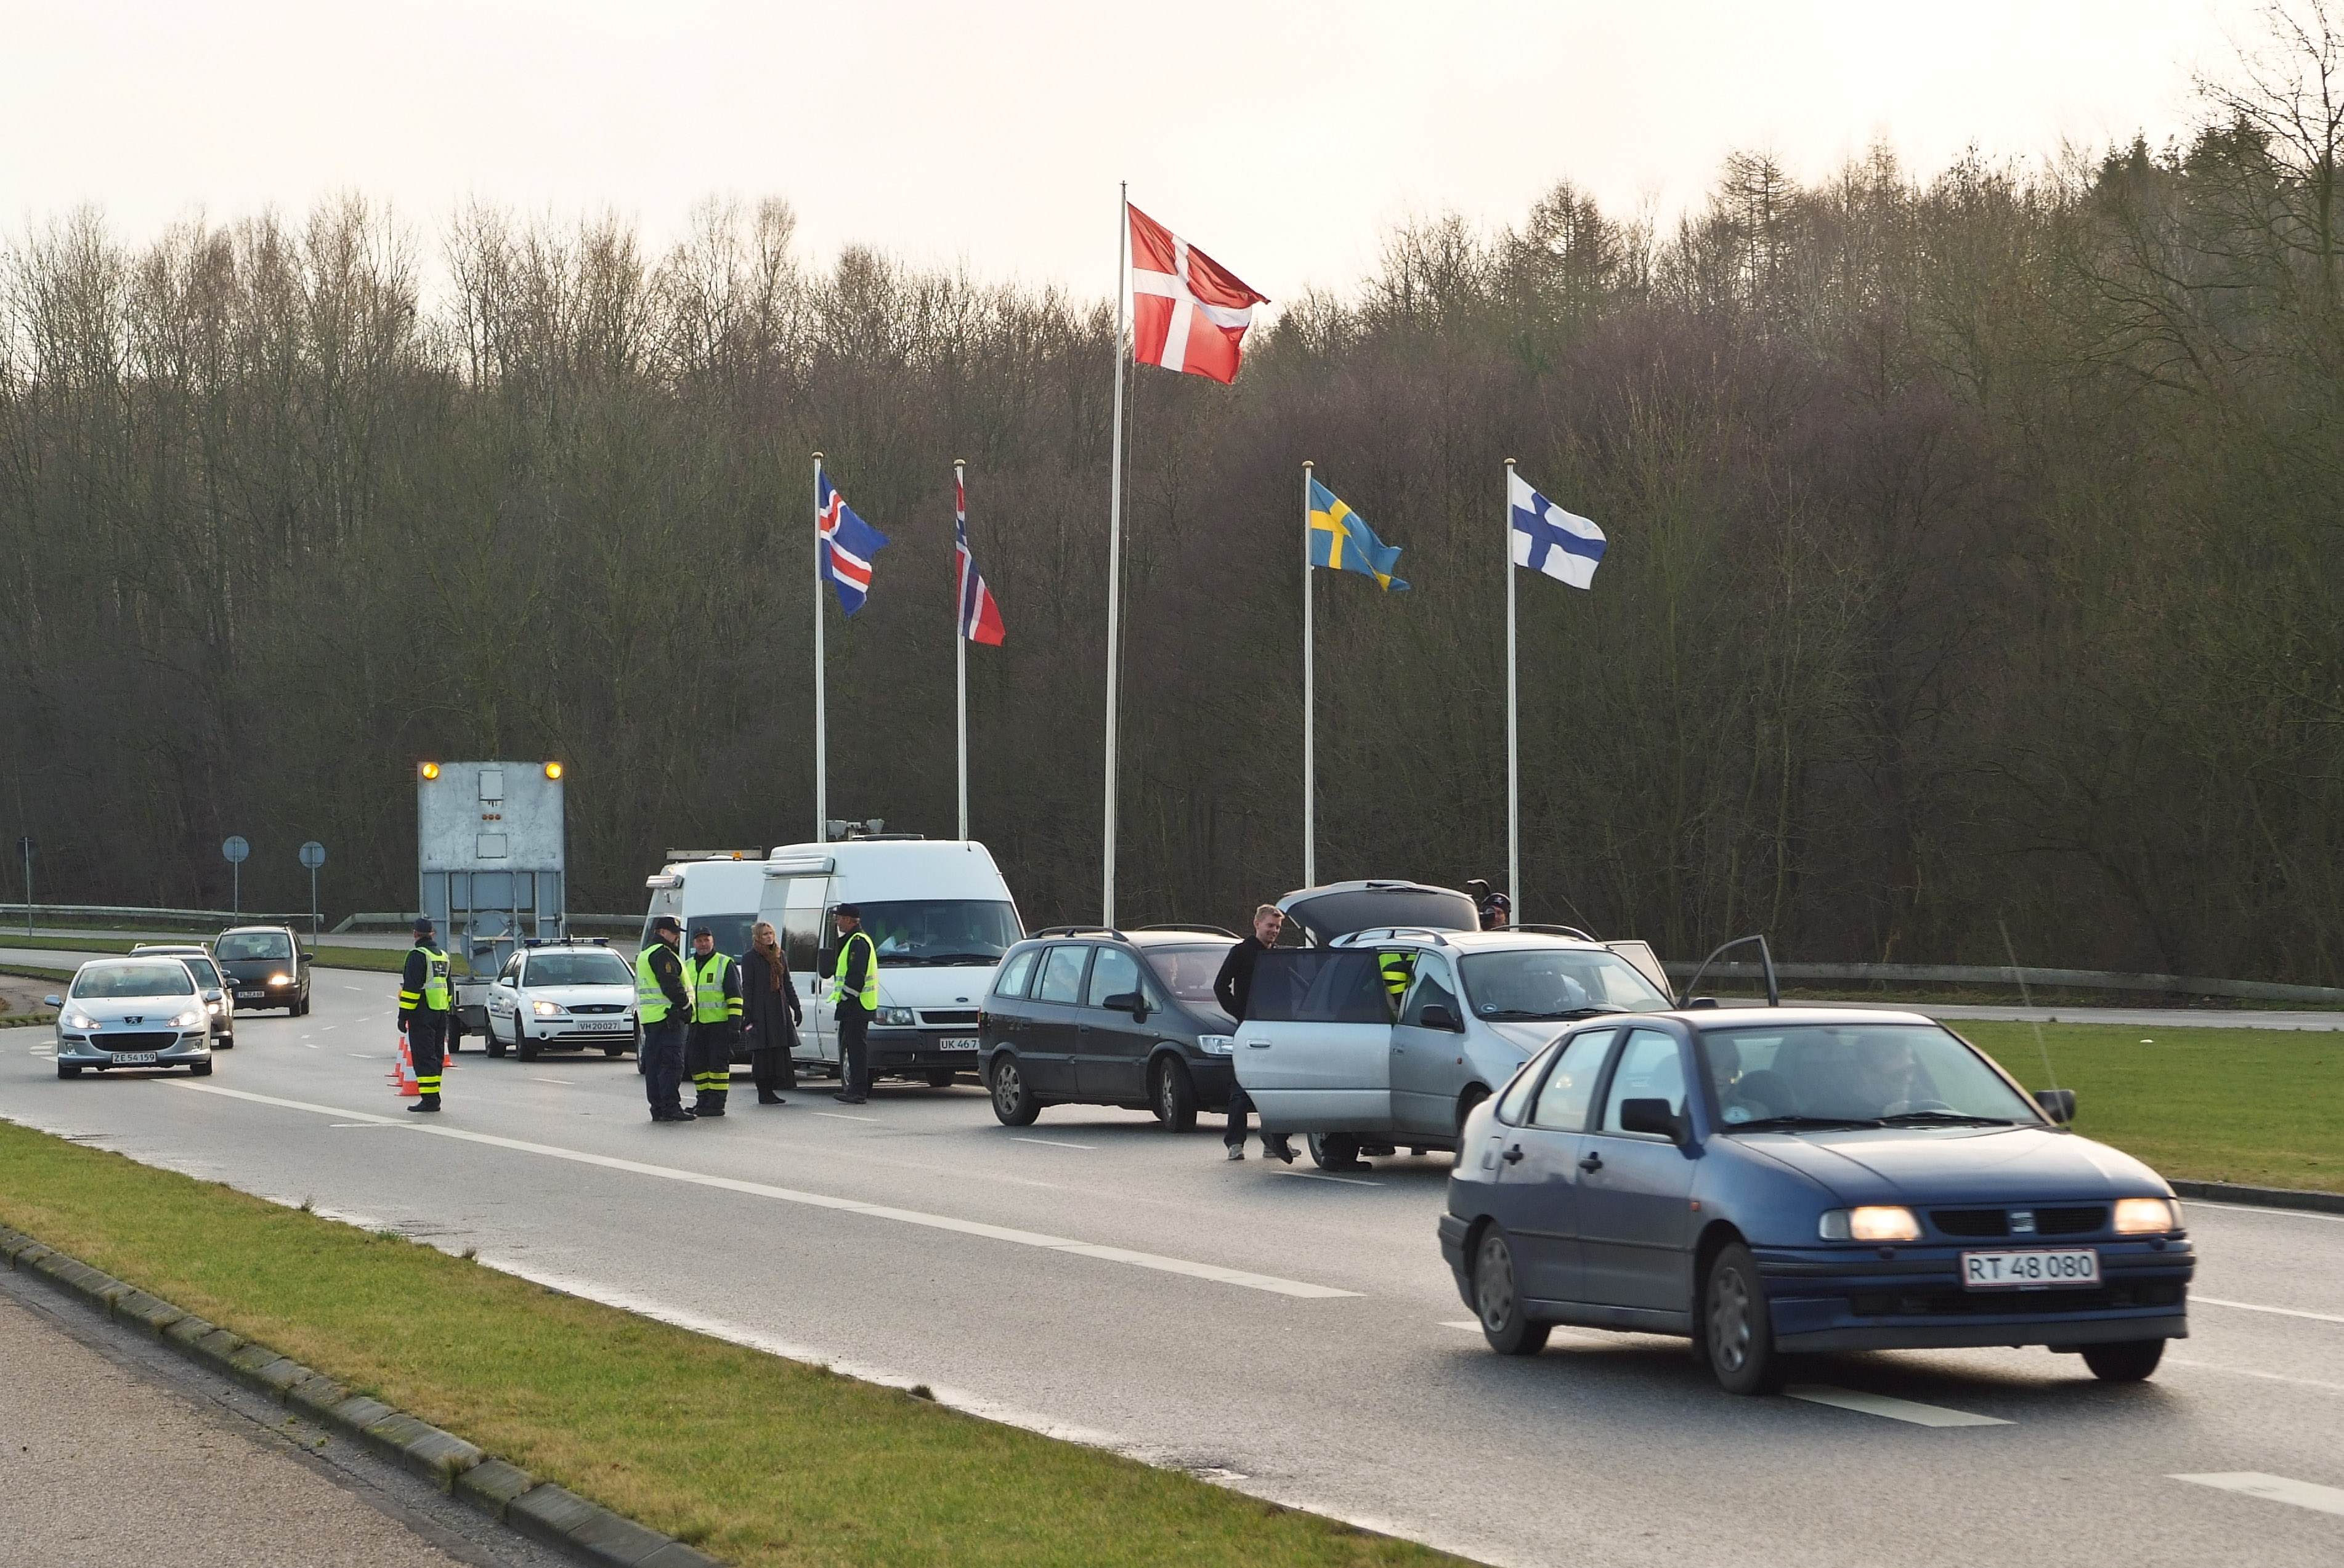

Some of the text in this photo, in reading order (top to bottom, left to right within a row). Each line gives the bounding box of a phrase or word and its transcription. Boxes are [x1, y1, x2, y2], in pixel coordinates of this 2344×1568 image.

[941, 1040, 955, 1049] UK
[957, 1039, 970, 1048] 46
[114, 1054, 126, 1062] ZE
[1969, 1256, 2092, 1279] RT 48 080
